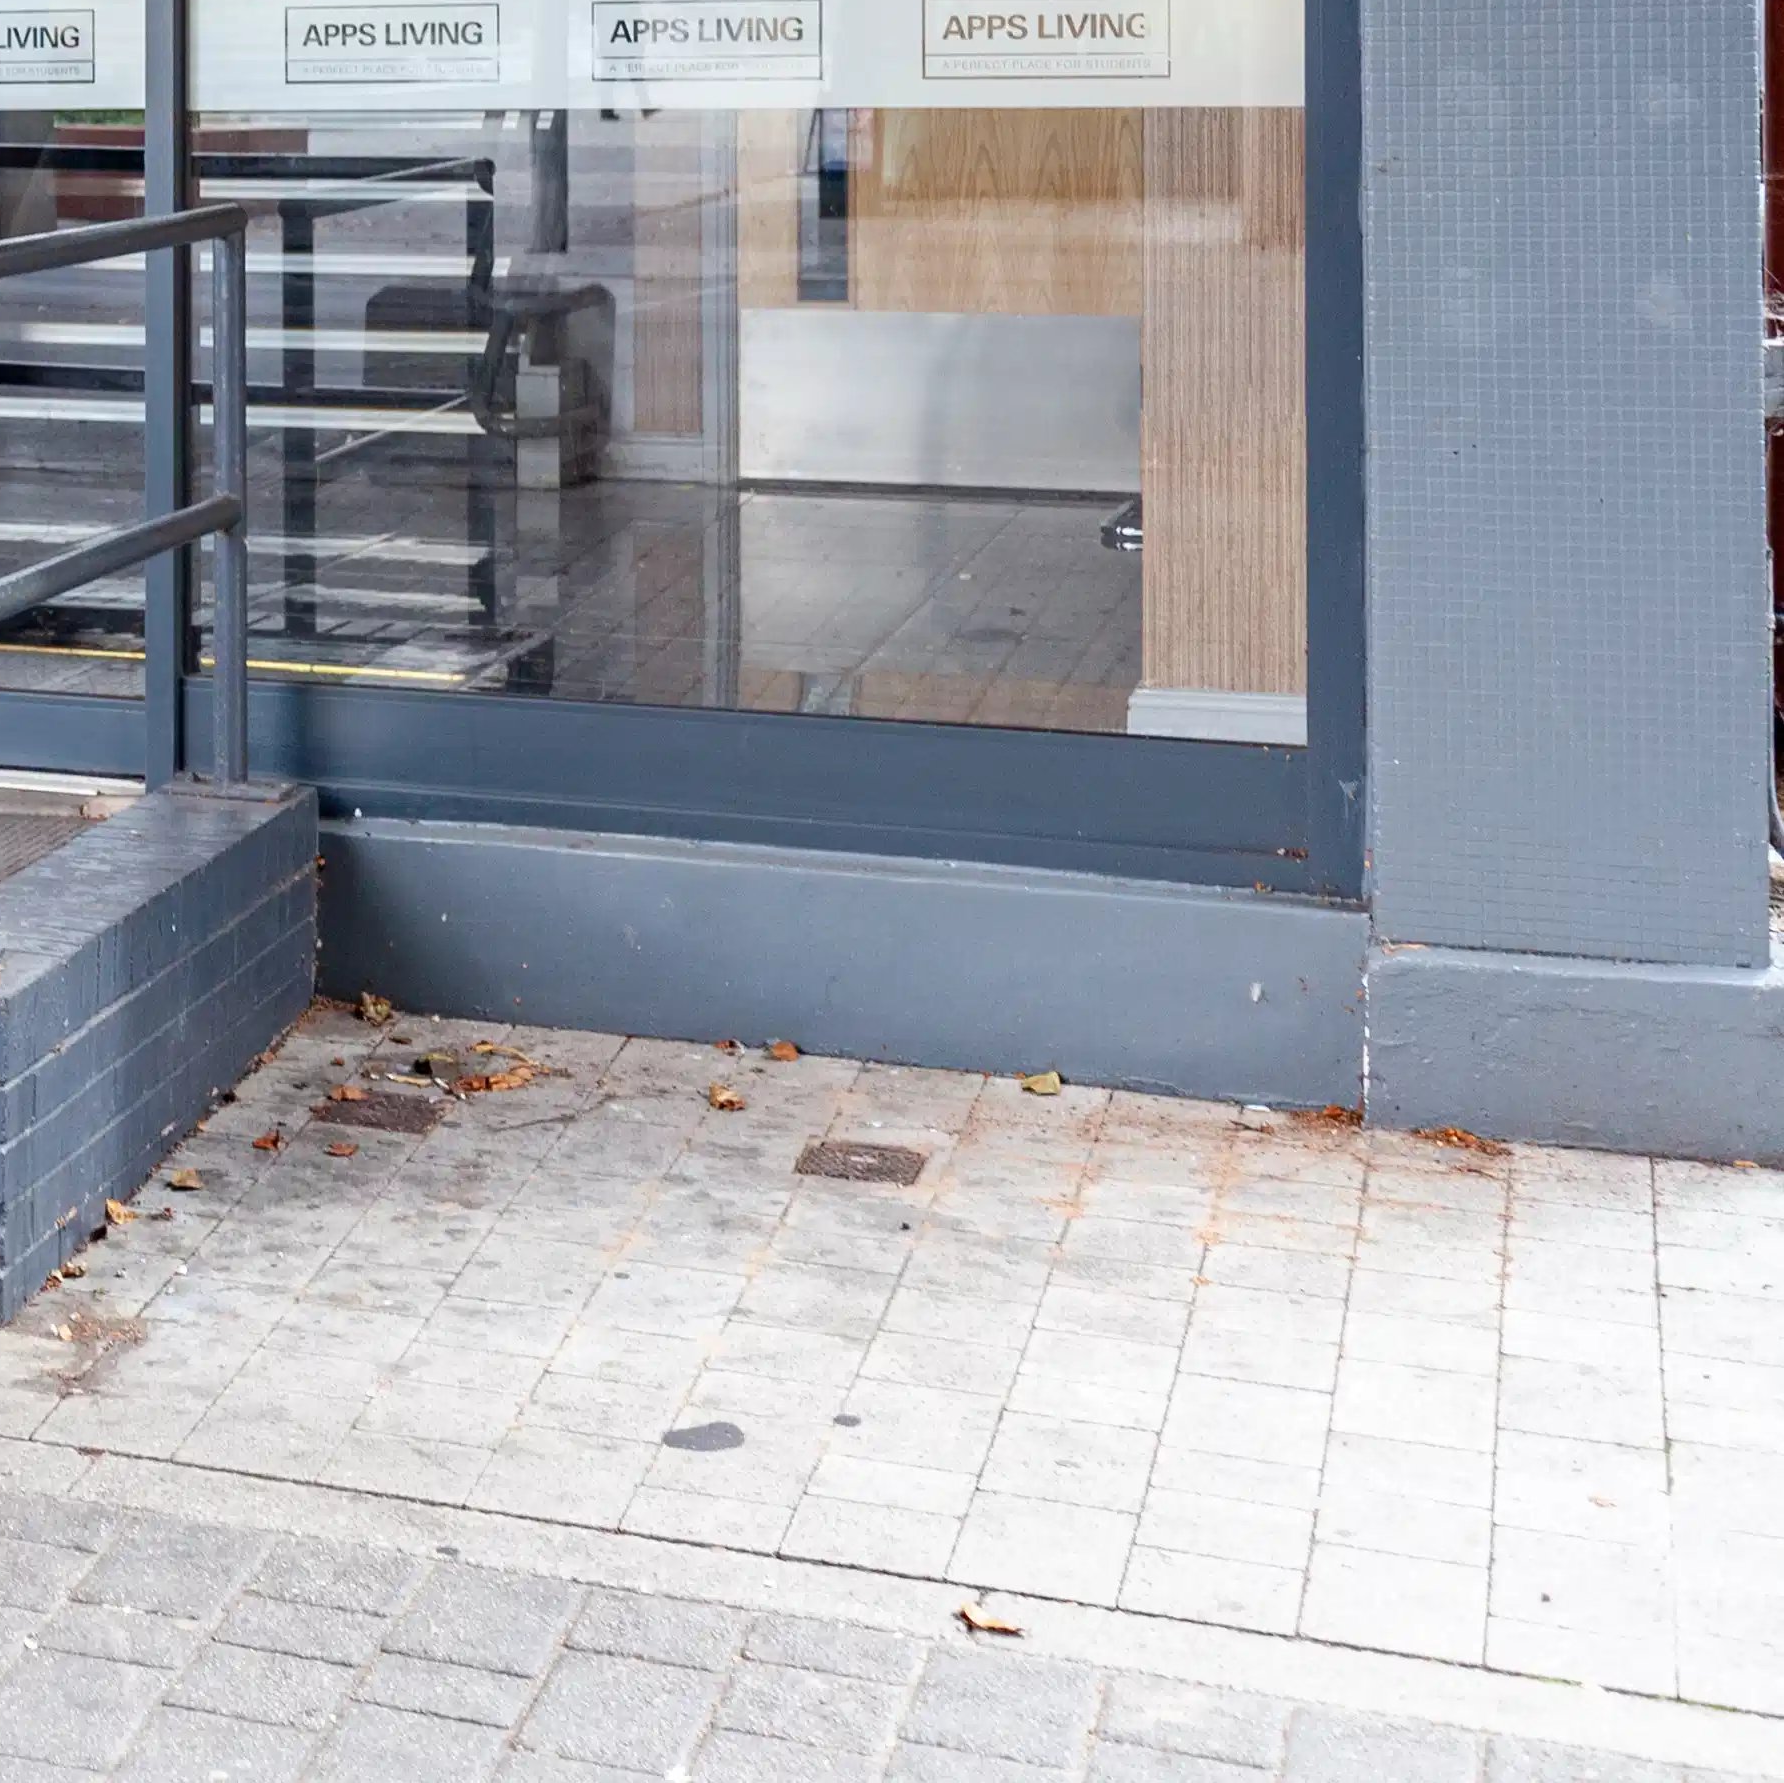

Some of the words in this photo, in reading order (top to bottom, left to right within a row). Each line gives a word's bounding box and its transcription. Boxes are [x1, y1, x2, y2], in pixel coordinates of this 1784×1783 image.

[302, 23, 376, 47] APPS
[385, 21, 483, 46] LIVING
[609, 18, 689, 44] APPS
[698, 16, 804, 42] LIVING
[942, 14, 1028, 40] APPS
[1037, 12, 1151, 39] LIVING
